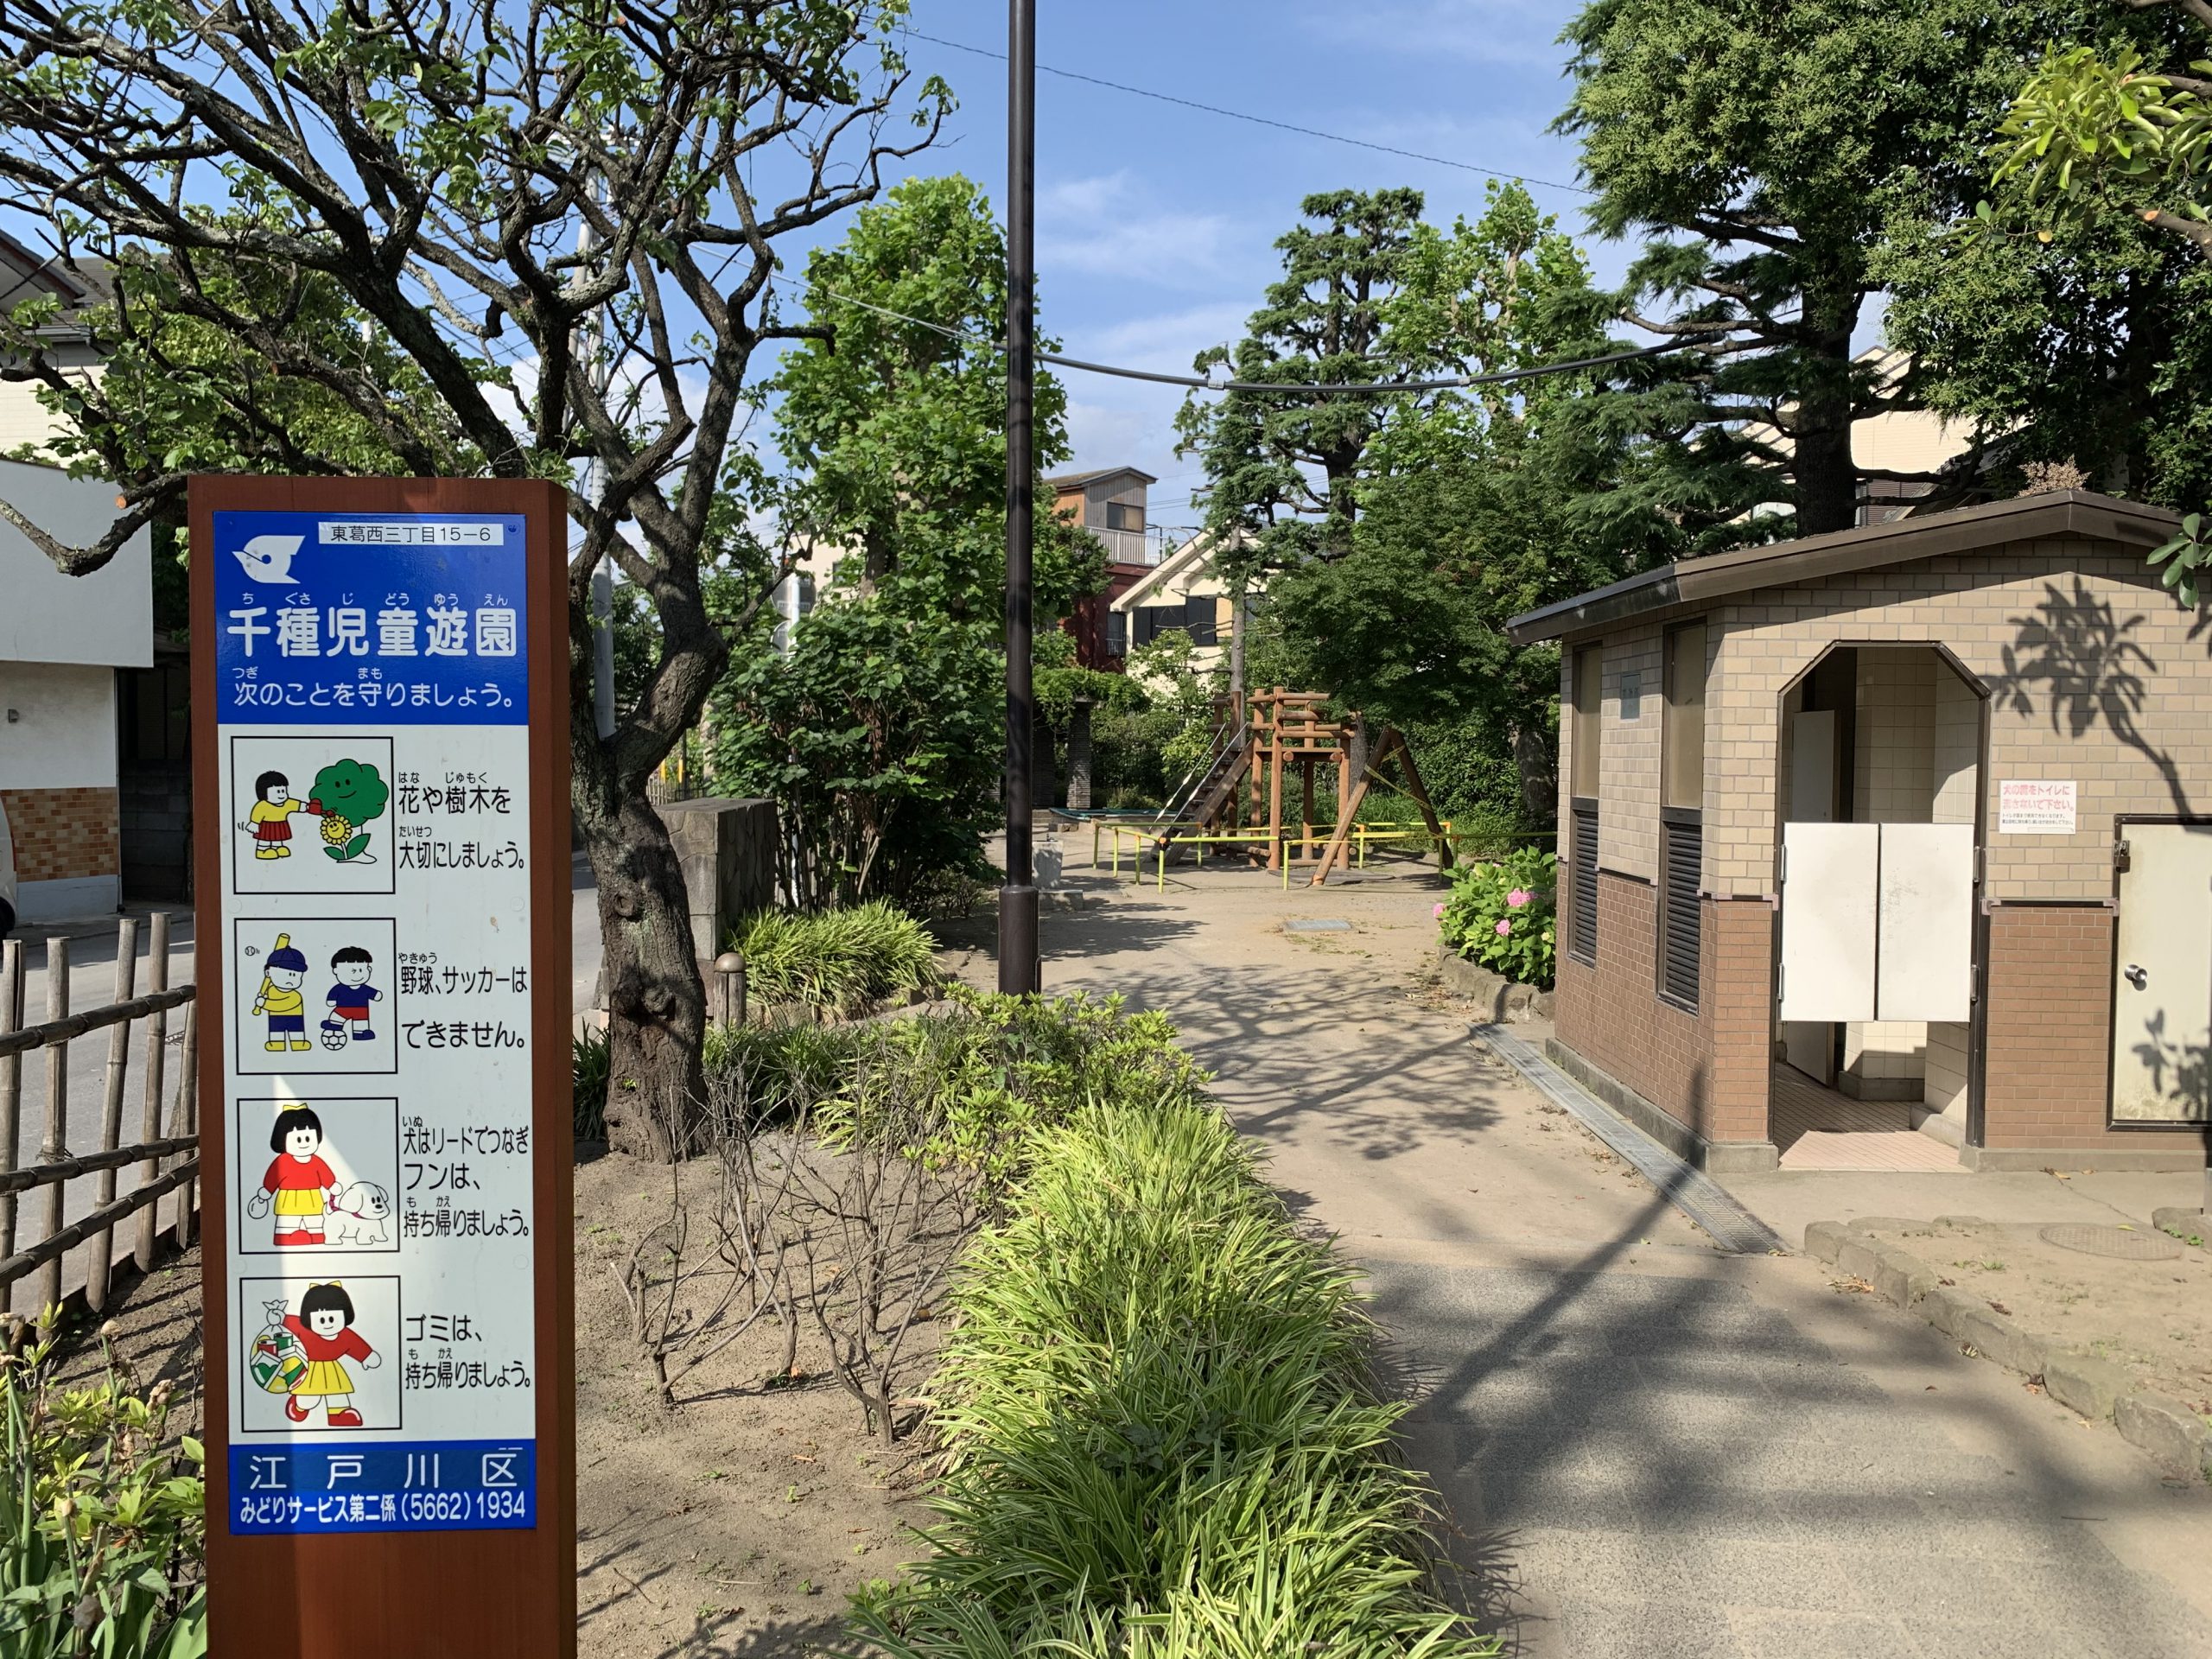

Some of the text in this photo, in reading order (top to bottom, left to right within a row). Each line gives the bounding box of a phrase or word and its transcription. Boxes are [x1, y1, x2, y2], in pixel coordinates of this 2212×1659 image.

[226, 607, 517, 658] 千種児童遊園
[233, 681, 512, 708] 次のことを守りましょう。
[398, 784, 512, 815] 花や樹木を
[398, 840, 524, 869] 大切にしましょう。
[401, 965, 528, 995] 野球、サッカーは
[401, 1019, 524, 1049] できません。
[403, 1123, 529, 1155] 犬はリードでつなぎ
[404, 1162, 480, 1191] フンは、
[404, 1209, 529, 1238] 持ち帰りましょう。
[406, 1313, 482, 1343] ゴミは、
[405, 1360, 531, 1390] 持ち帰りましょう。
[250, 1453, 518, 1490] 江戸川区
